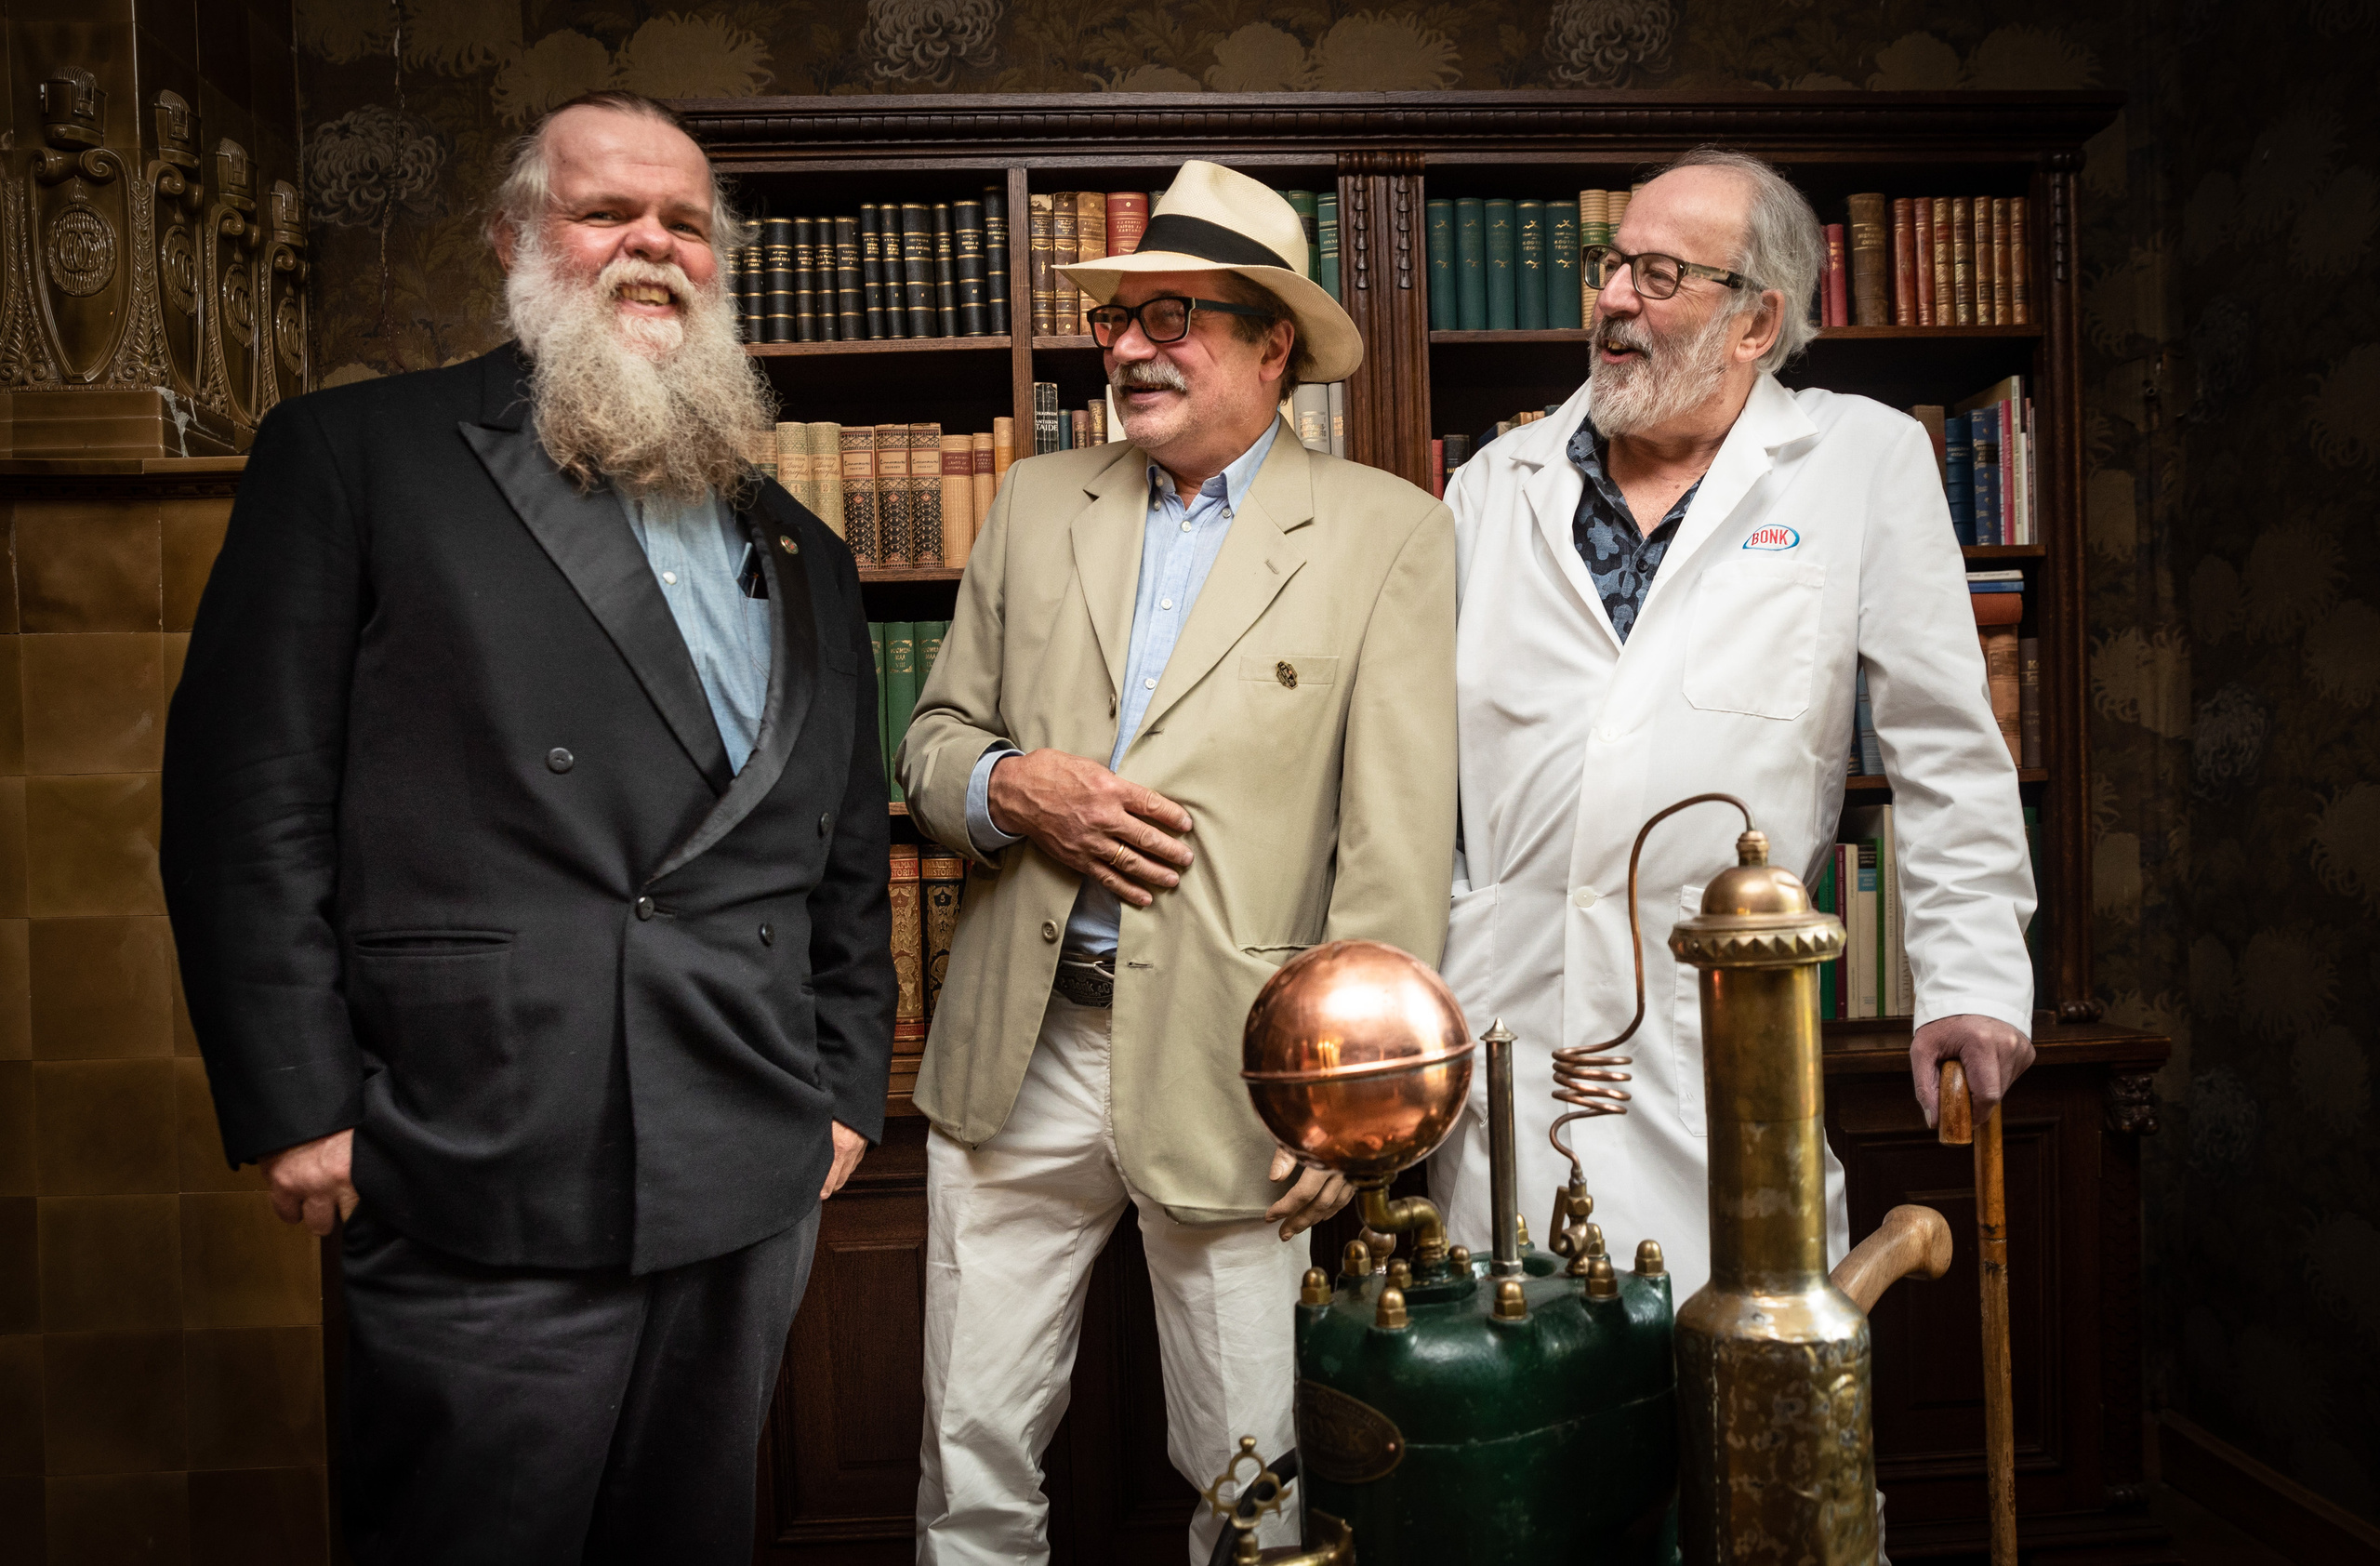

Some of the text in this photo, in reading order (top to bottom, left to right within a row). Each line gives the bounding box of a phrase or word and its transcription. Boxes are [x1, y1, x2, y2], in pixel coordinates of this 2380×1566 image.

[822, 484, 828, 492] 2
[1751, 528, 1790, 547] BONK
[891, 869, 915, 877] STORIA
[940, 895, 945, 903] 5
